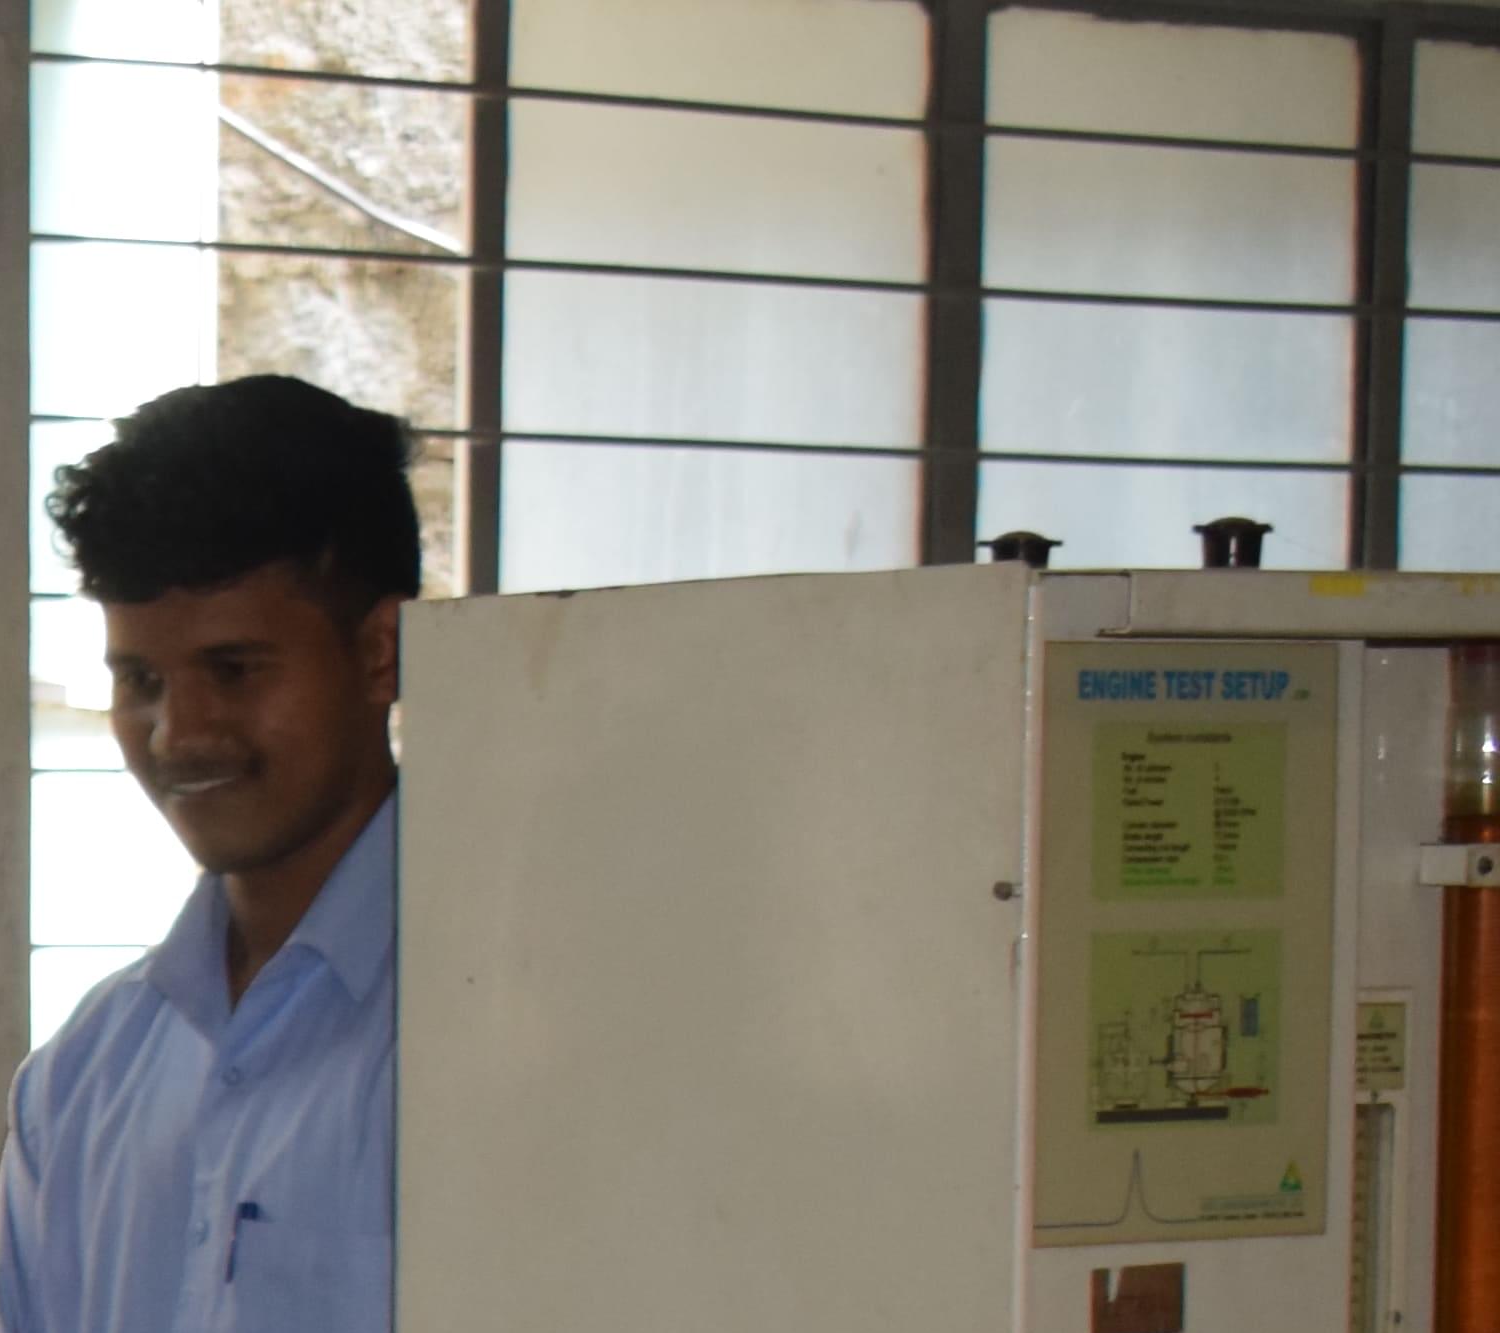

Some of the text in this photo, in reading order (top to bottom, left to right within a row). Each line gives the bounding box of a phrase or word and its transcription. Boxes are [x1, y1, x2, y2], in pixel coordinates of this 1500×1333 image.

[1078, 669, 1289, 700] ENGINE TEST SETUP
